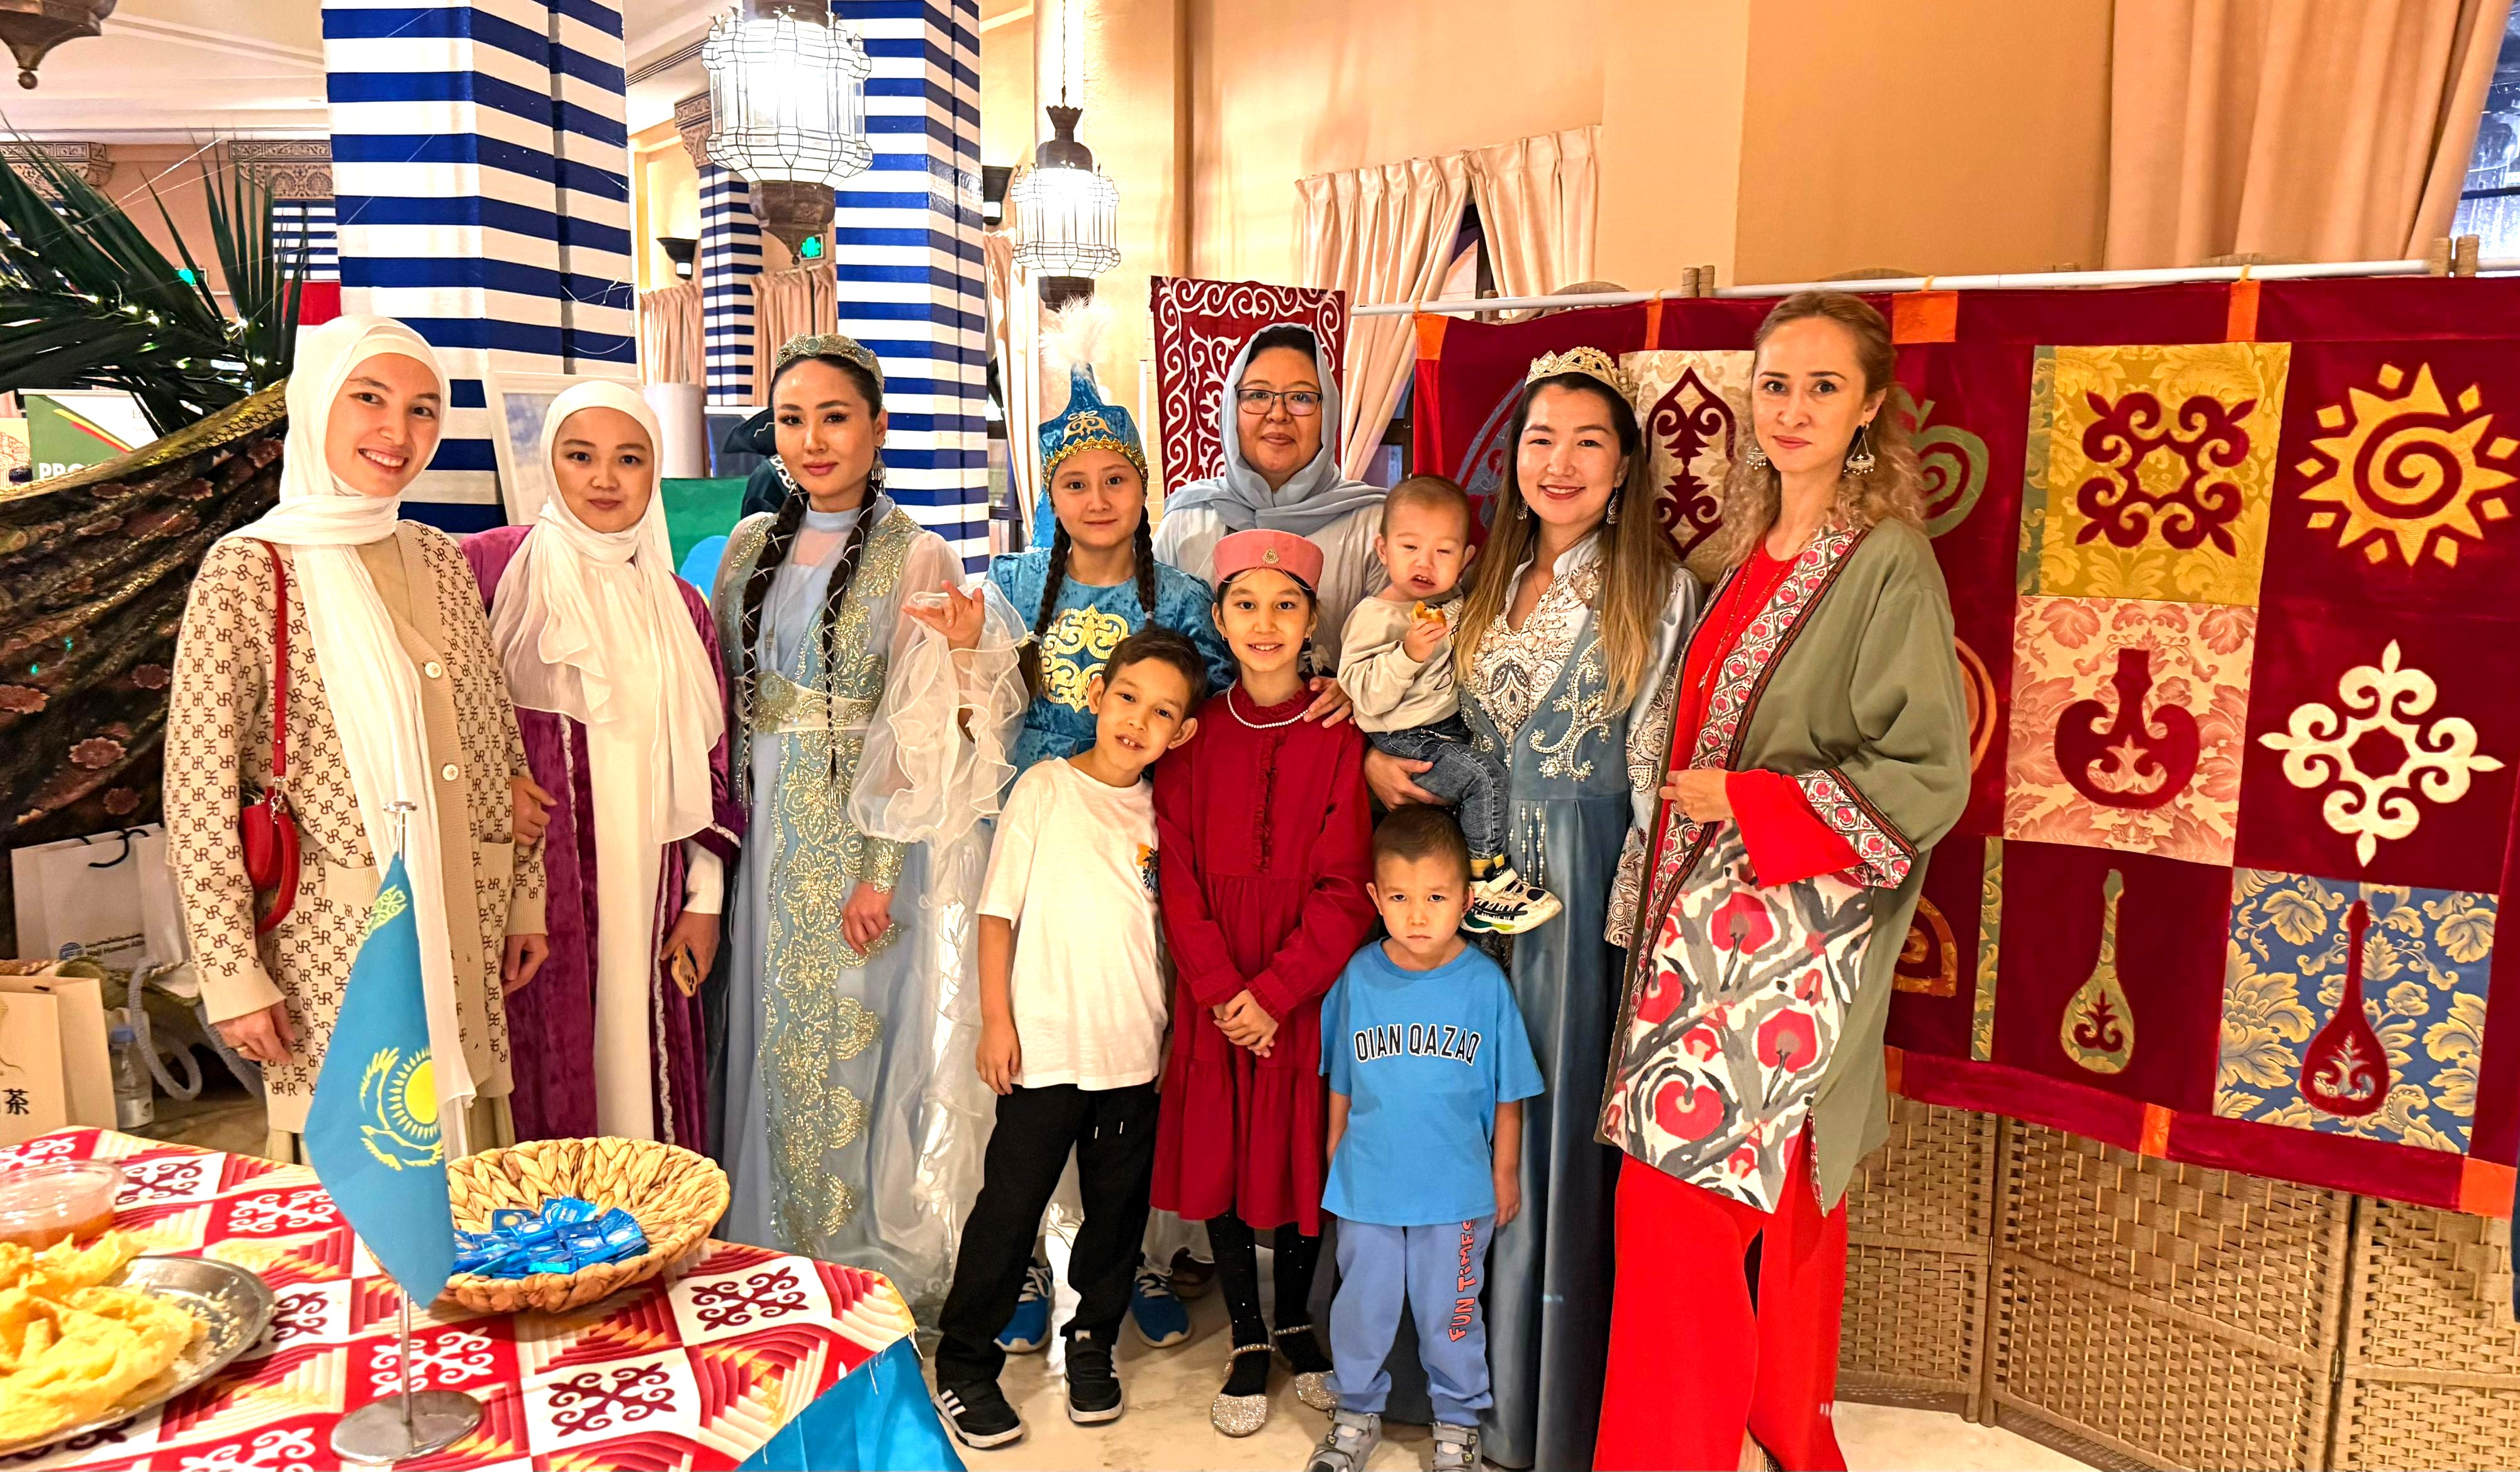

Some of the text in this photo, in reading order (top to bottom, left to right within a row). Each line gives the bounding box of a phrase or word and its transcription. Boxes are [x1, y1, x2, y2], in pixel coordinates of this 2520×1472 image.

[1354, 1023, 1481, 1066] OIAN QAZAQ
[2, 1088, 30, 1115] 茶
[1448, 1297, 1476, 1342] FUN
